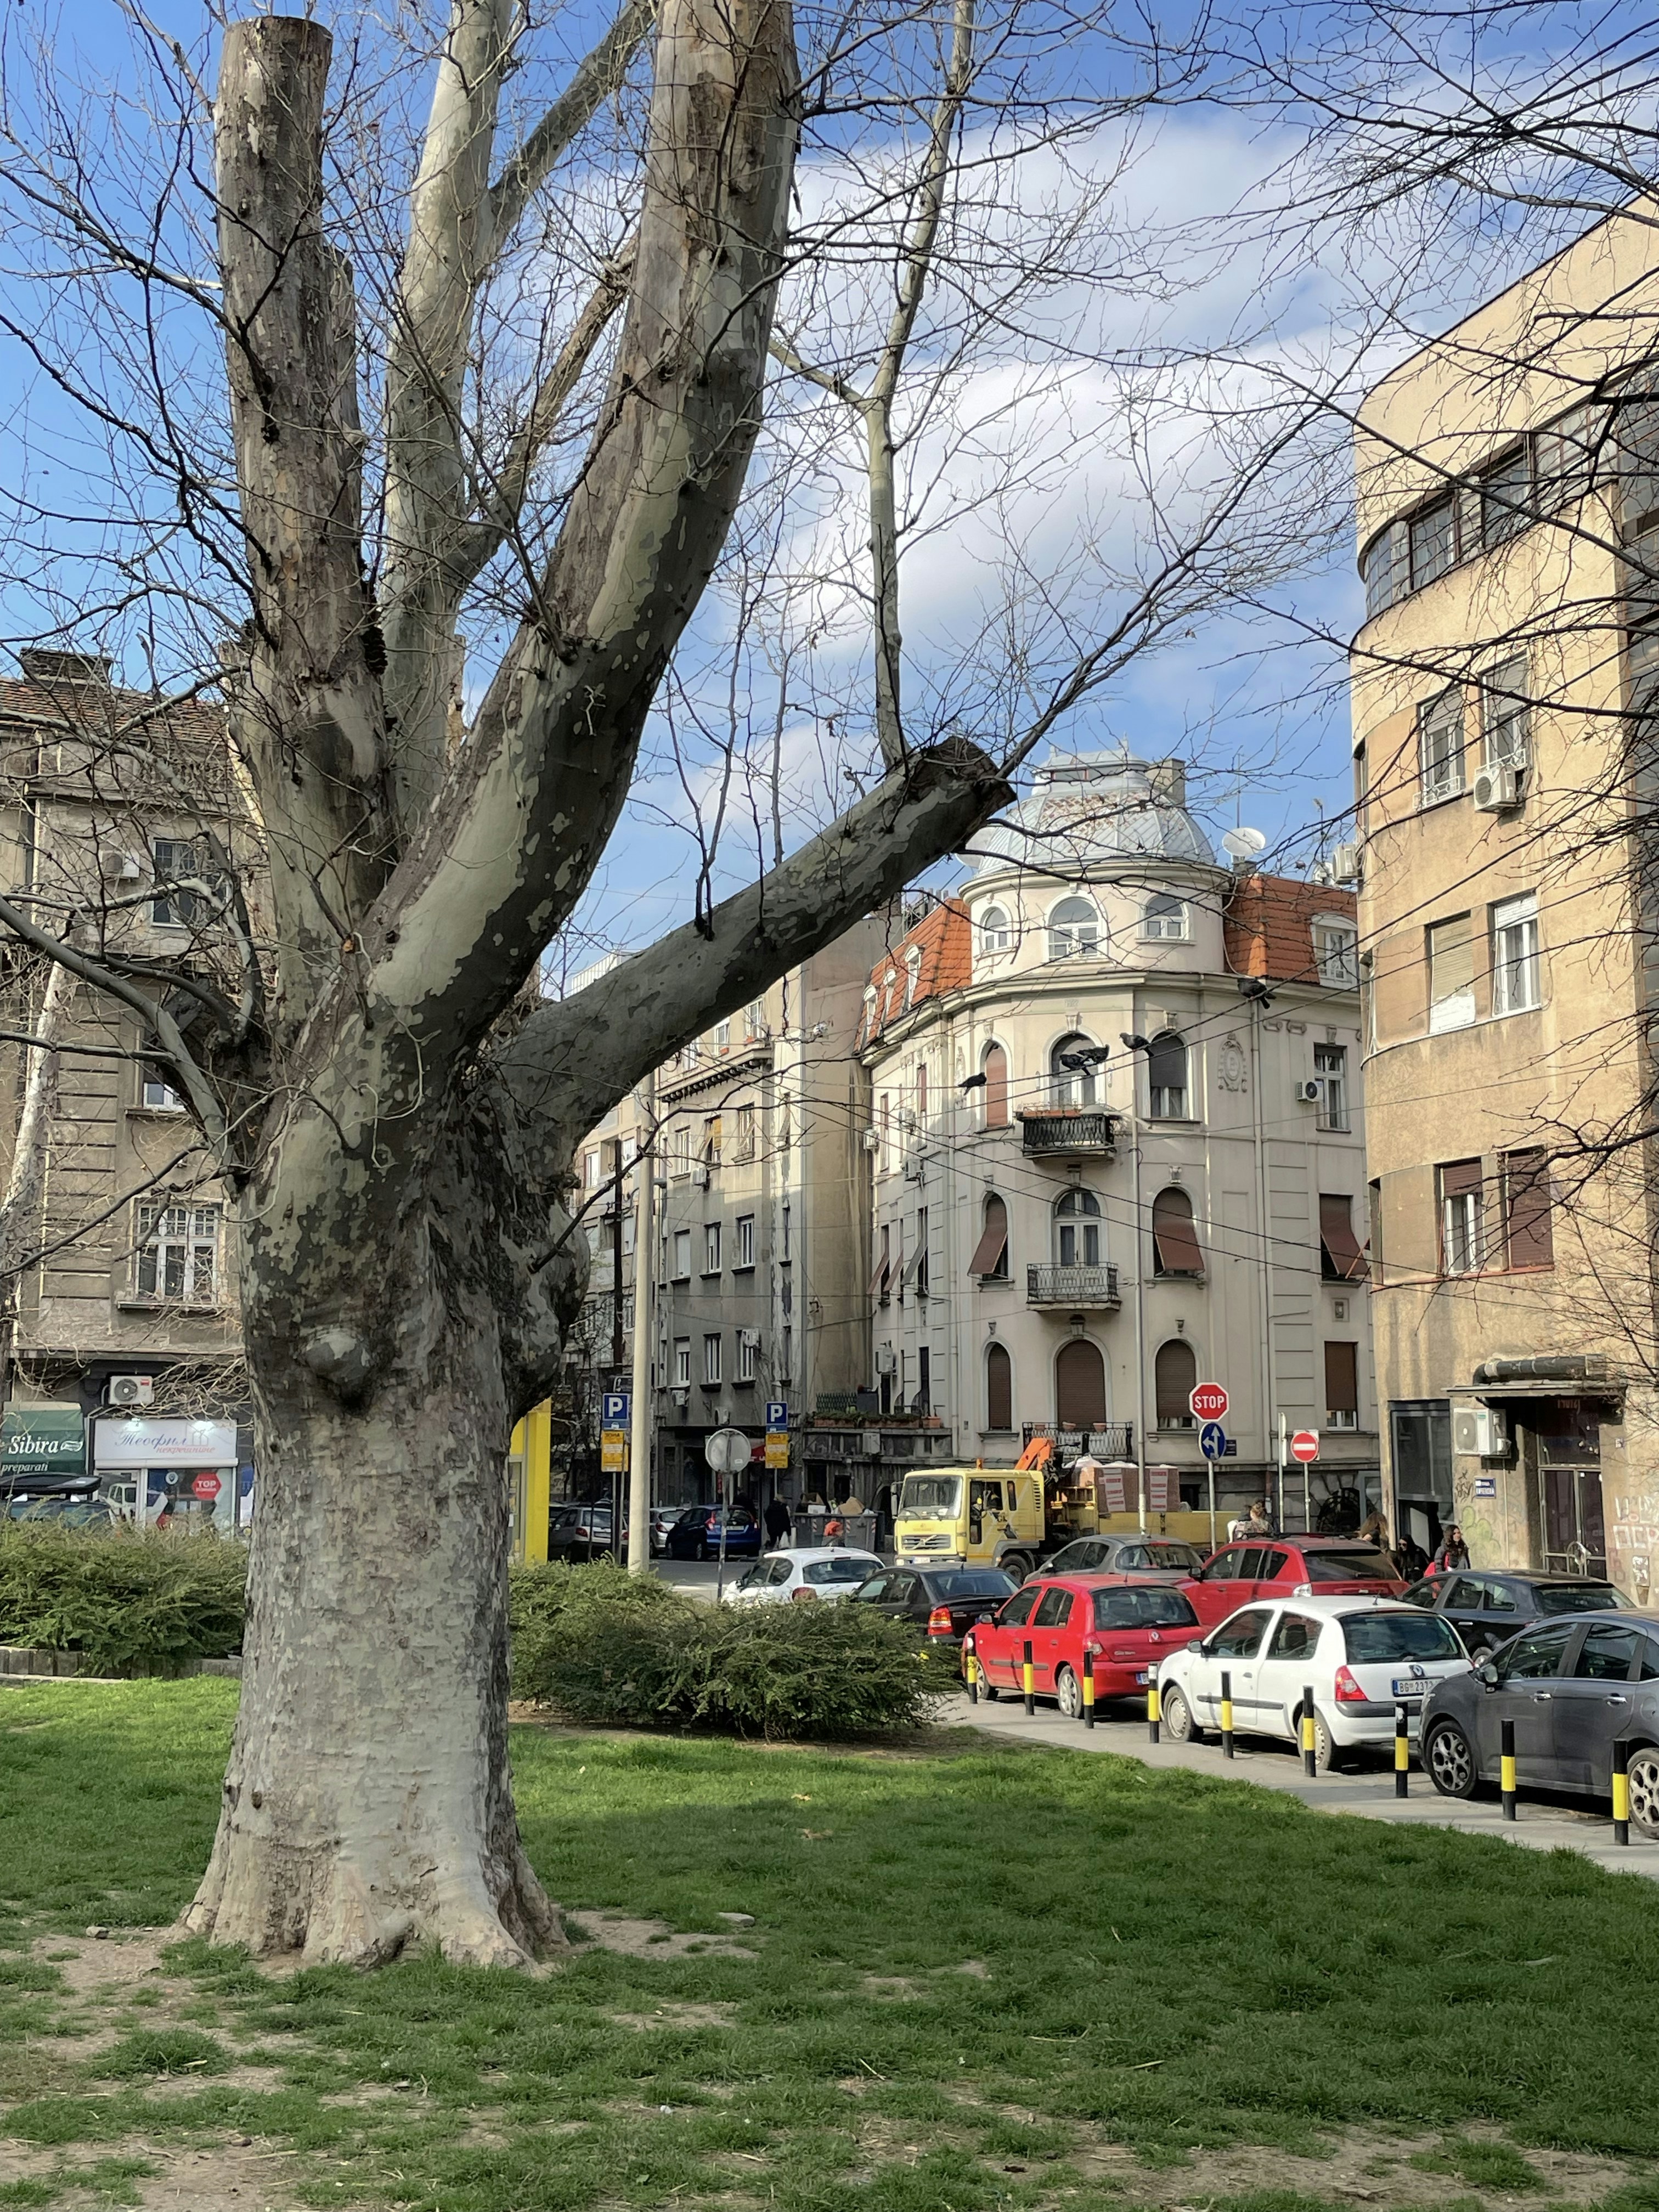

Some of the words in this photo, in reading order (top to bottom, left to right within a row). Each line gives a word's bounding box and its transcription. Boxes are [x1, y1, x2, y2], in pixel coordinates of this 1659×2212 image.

[608, 1397, 623, 1417] P
[1194, 1395, 1224, 1409] STOP
[770, 1404, 783, 1422] P
[8, 1435, 59, 1454] Sibira
[1, 1463, 48, 1476] preparati
[1400, 1683, 1409, 1692] BG
